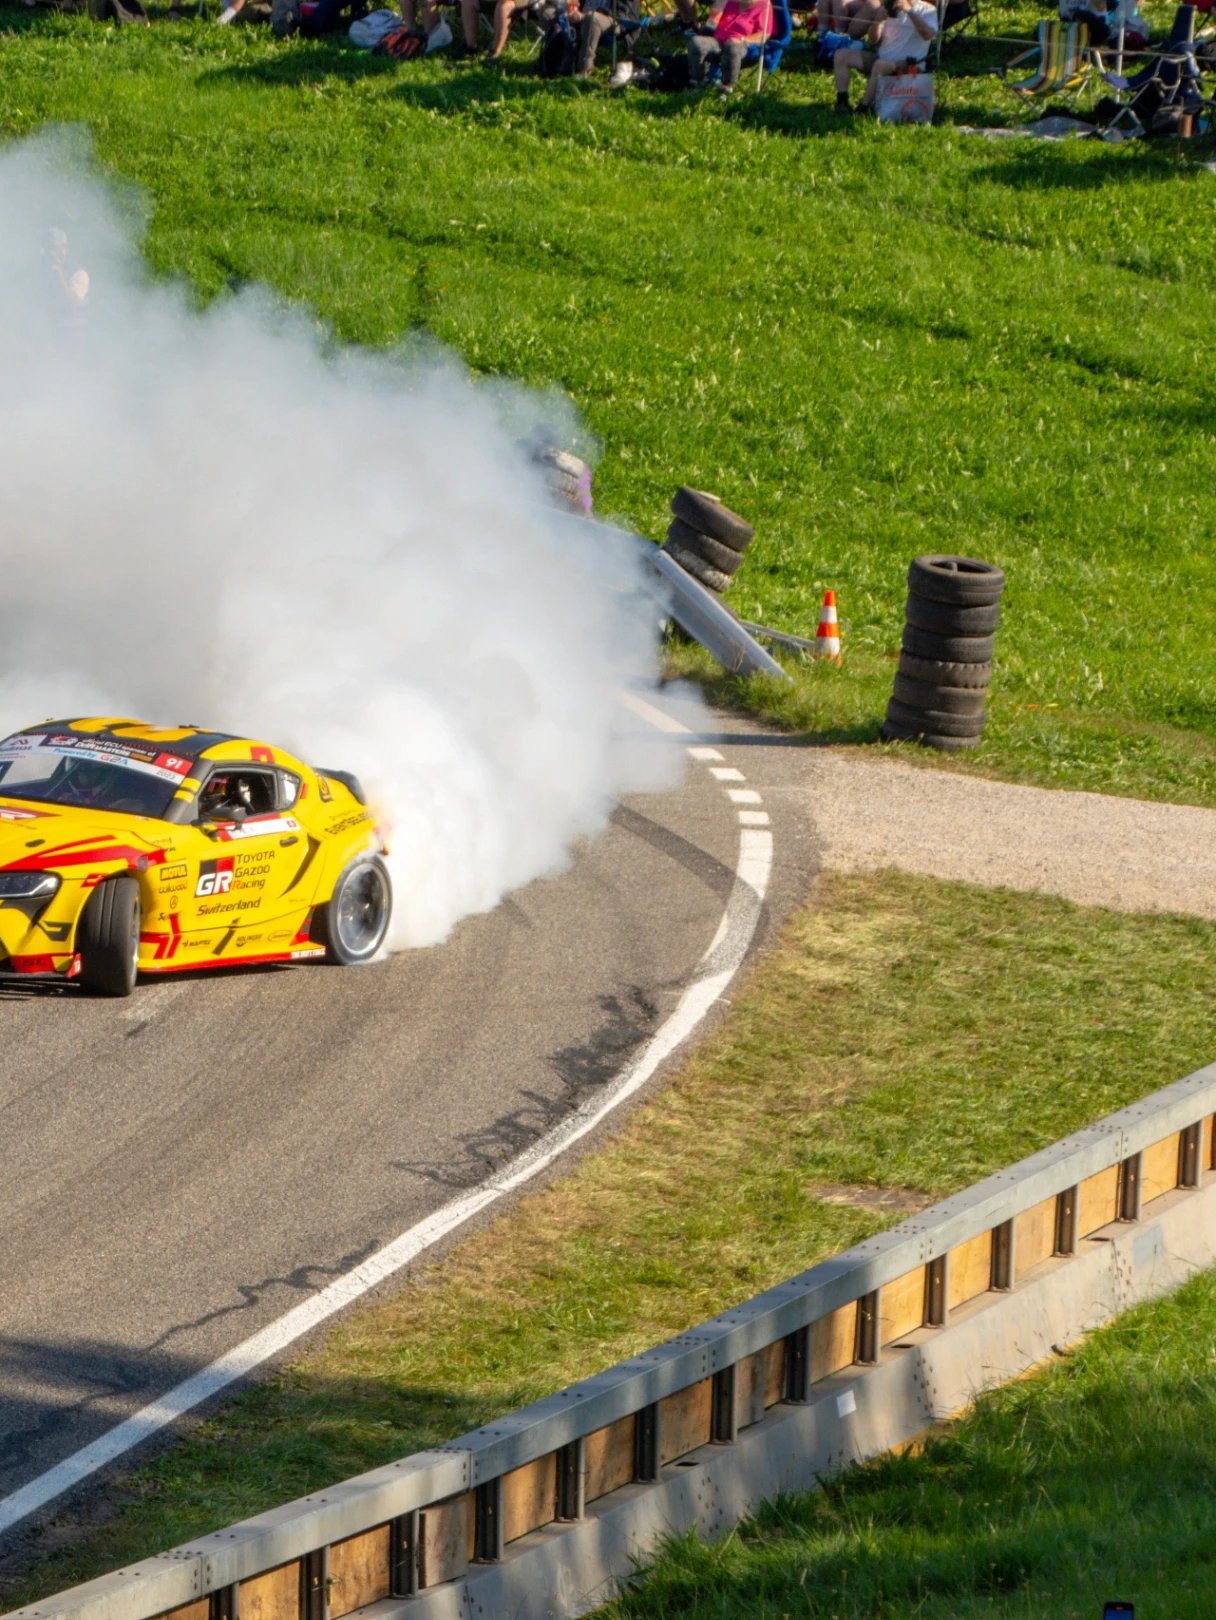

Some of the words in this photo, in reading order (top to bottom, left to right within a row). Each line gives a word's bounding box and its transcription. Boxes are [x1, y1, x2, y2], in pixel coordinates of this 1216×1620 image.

[166, 757, 183, 769] 91
[237, 850, 275, 864] TOYOTA
[235, 864, 270, 878] GAZOO
[195, 870, 233, 896] GR
[232, 879, 265, 890] Racing
[196, 896, 262, 916] Switzerland
